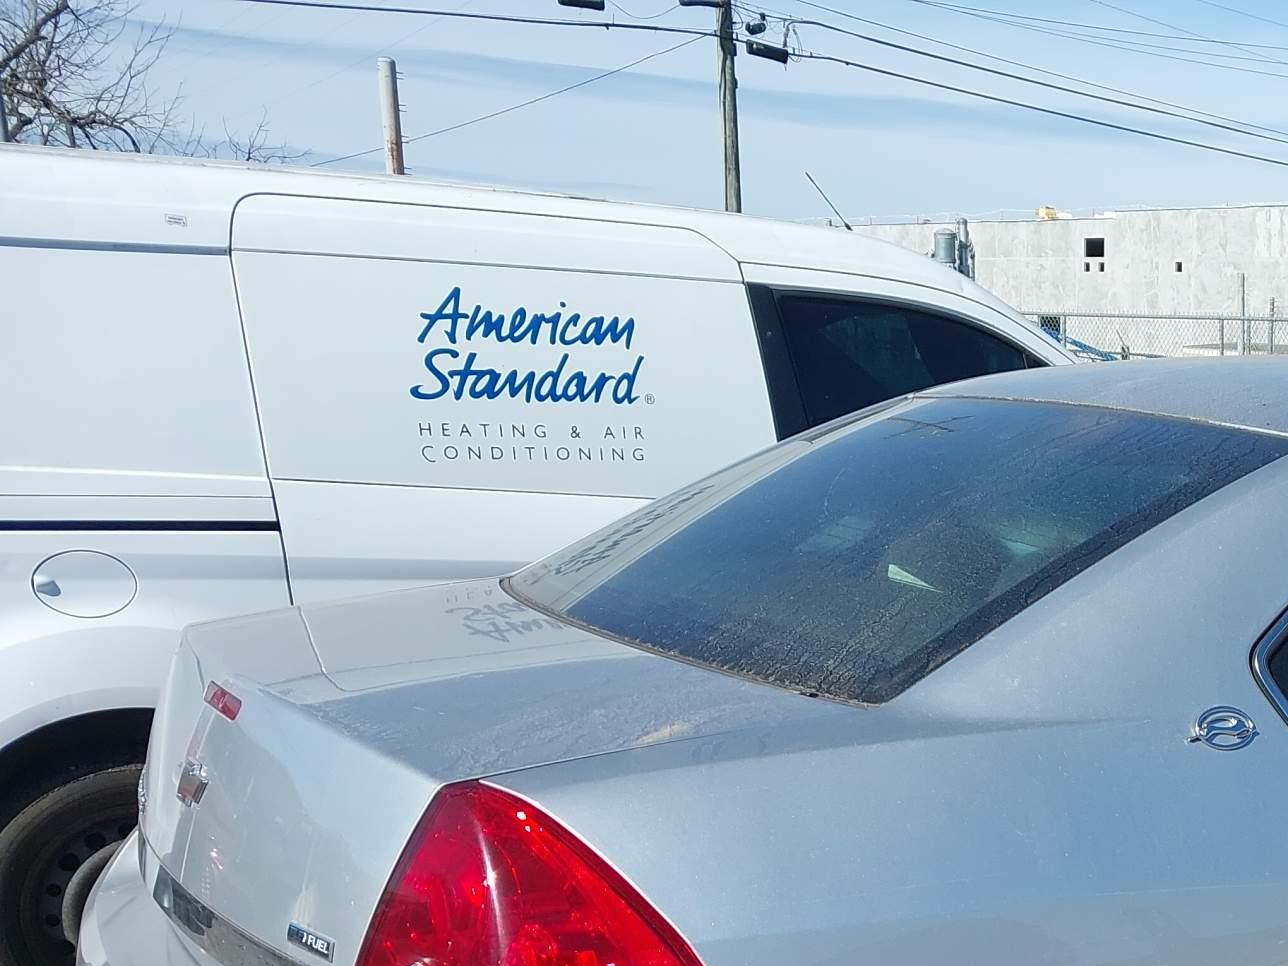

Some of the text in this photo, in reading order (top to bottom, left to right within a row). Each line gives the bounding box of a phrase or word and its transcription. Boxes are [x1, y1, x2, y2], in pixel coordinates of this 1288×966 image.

[417, 286, 635, 350] American
[418, 422, 645, 440] HEATING & AIR
[421, 445, 645, 463] CONDITIONING
